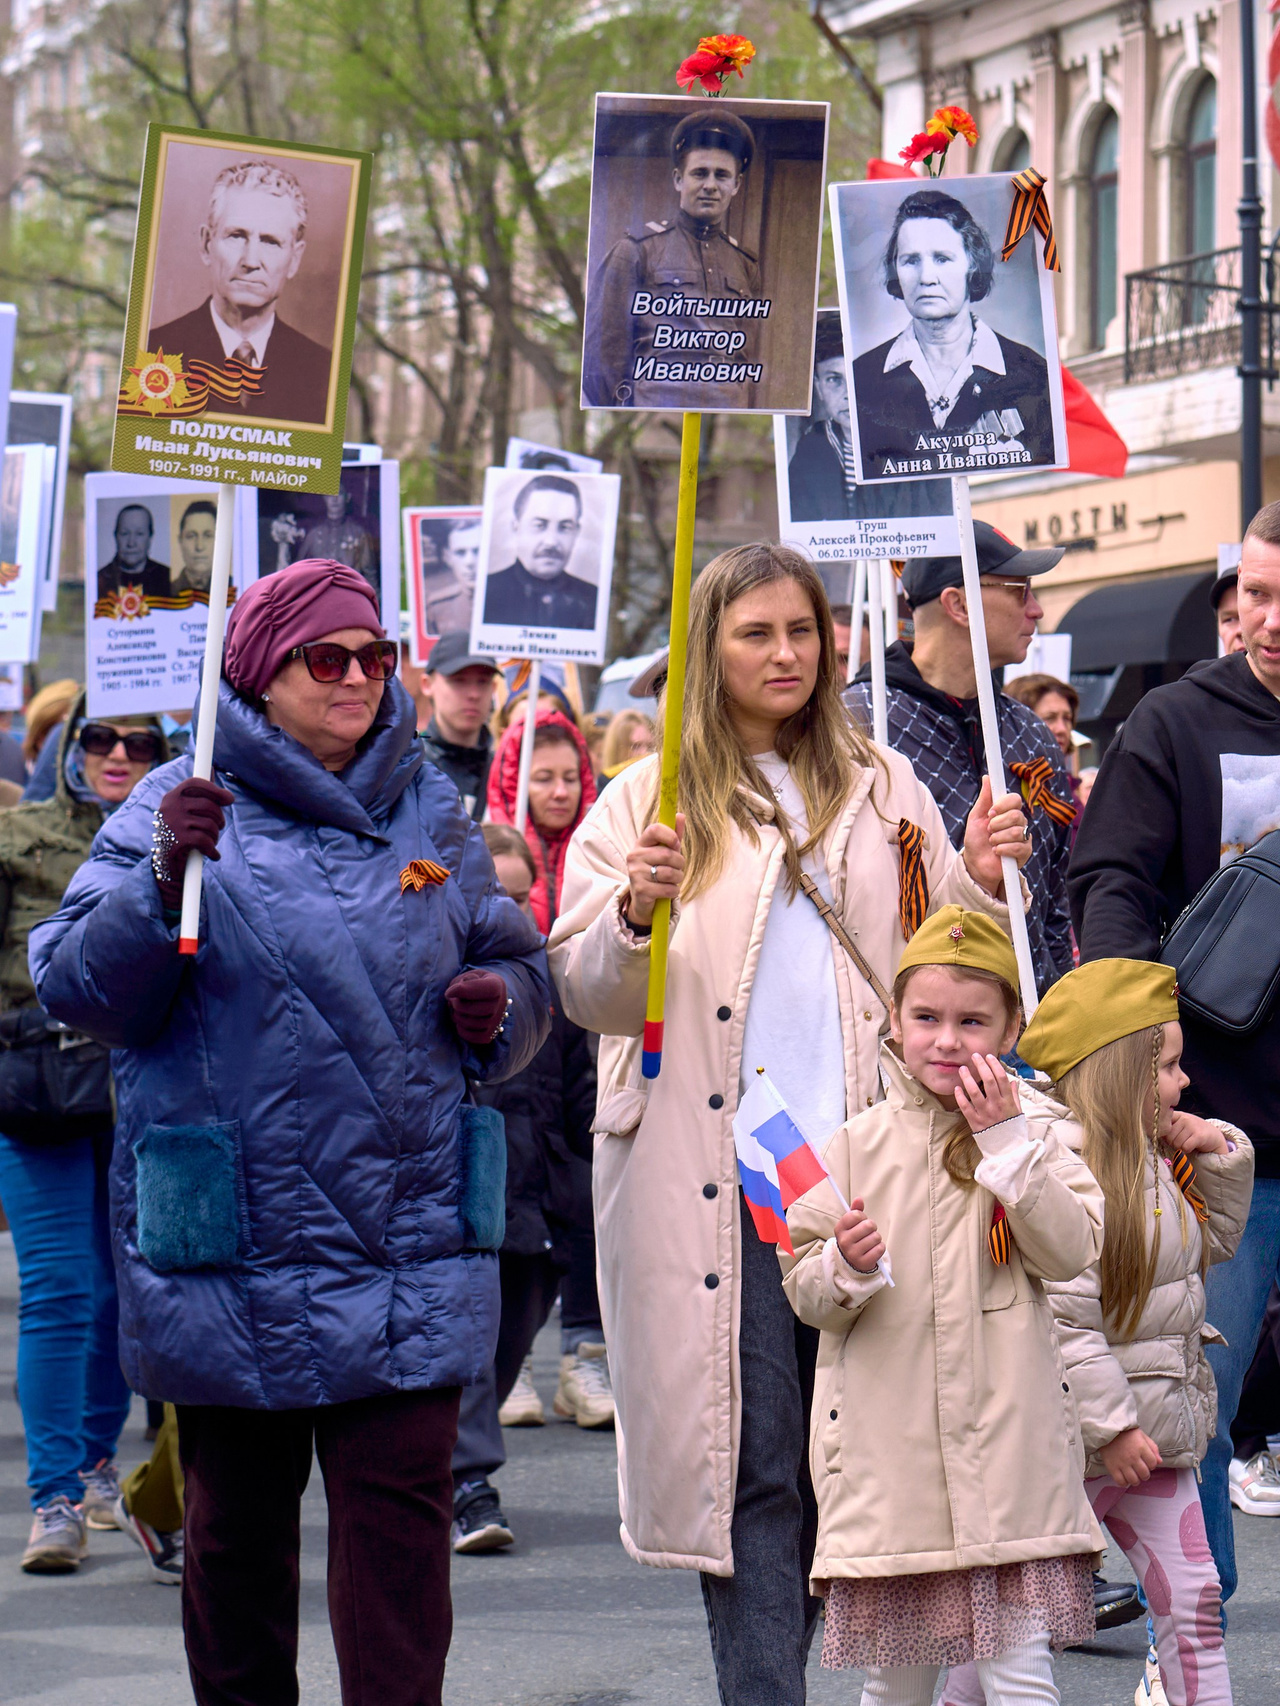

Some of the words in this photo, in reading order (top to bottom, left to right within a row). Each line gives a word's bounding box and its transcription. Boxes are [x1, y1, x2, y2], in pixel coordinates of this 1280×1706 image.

[632, 291, 771, 317] Войтышин
[653, 325, 745, 354] Виктор
[633, 357, 763, 382] Иванович
[170, 420, 293, 447] ПОЛУСМАК
[914, 431, 997, 453] Акулова
[135, 435, 190, 456] Иван
[193, 442, 322, 470] Лукьянович
[882, 457, 933, 475] Анна
[937, 450, 1032, 470] Ивановна
[250, 468, 308, 487] МАЙОР
[809, 533, 857, 546] Алексей
[860, 530, 936, 546] Прокофьевич
[856, 519, 887, 533] Труш
[818, 545, 928, 558] 06.02.1910-23.08.1977
